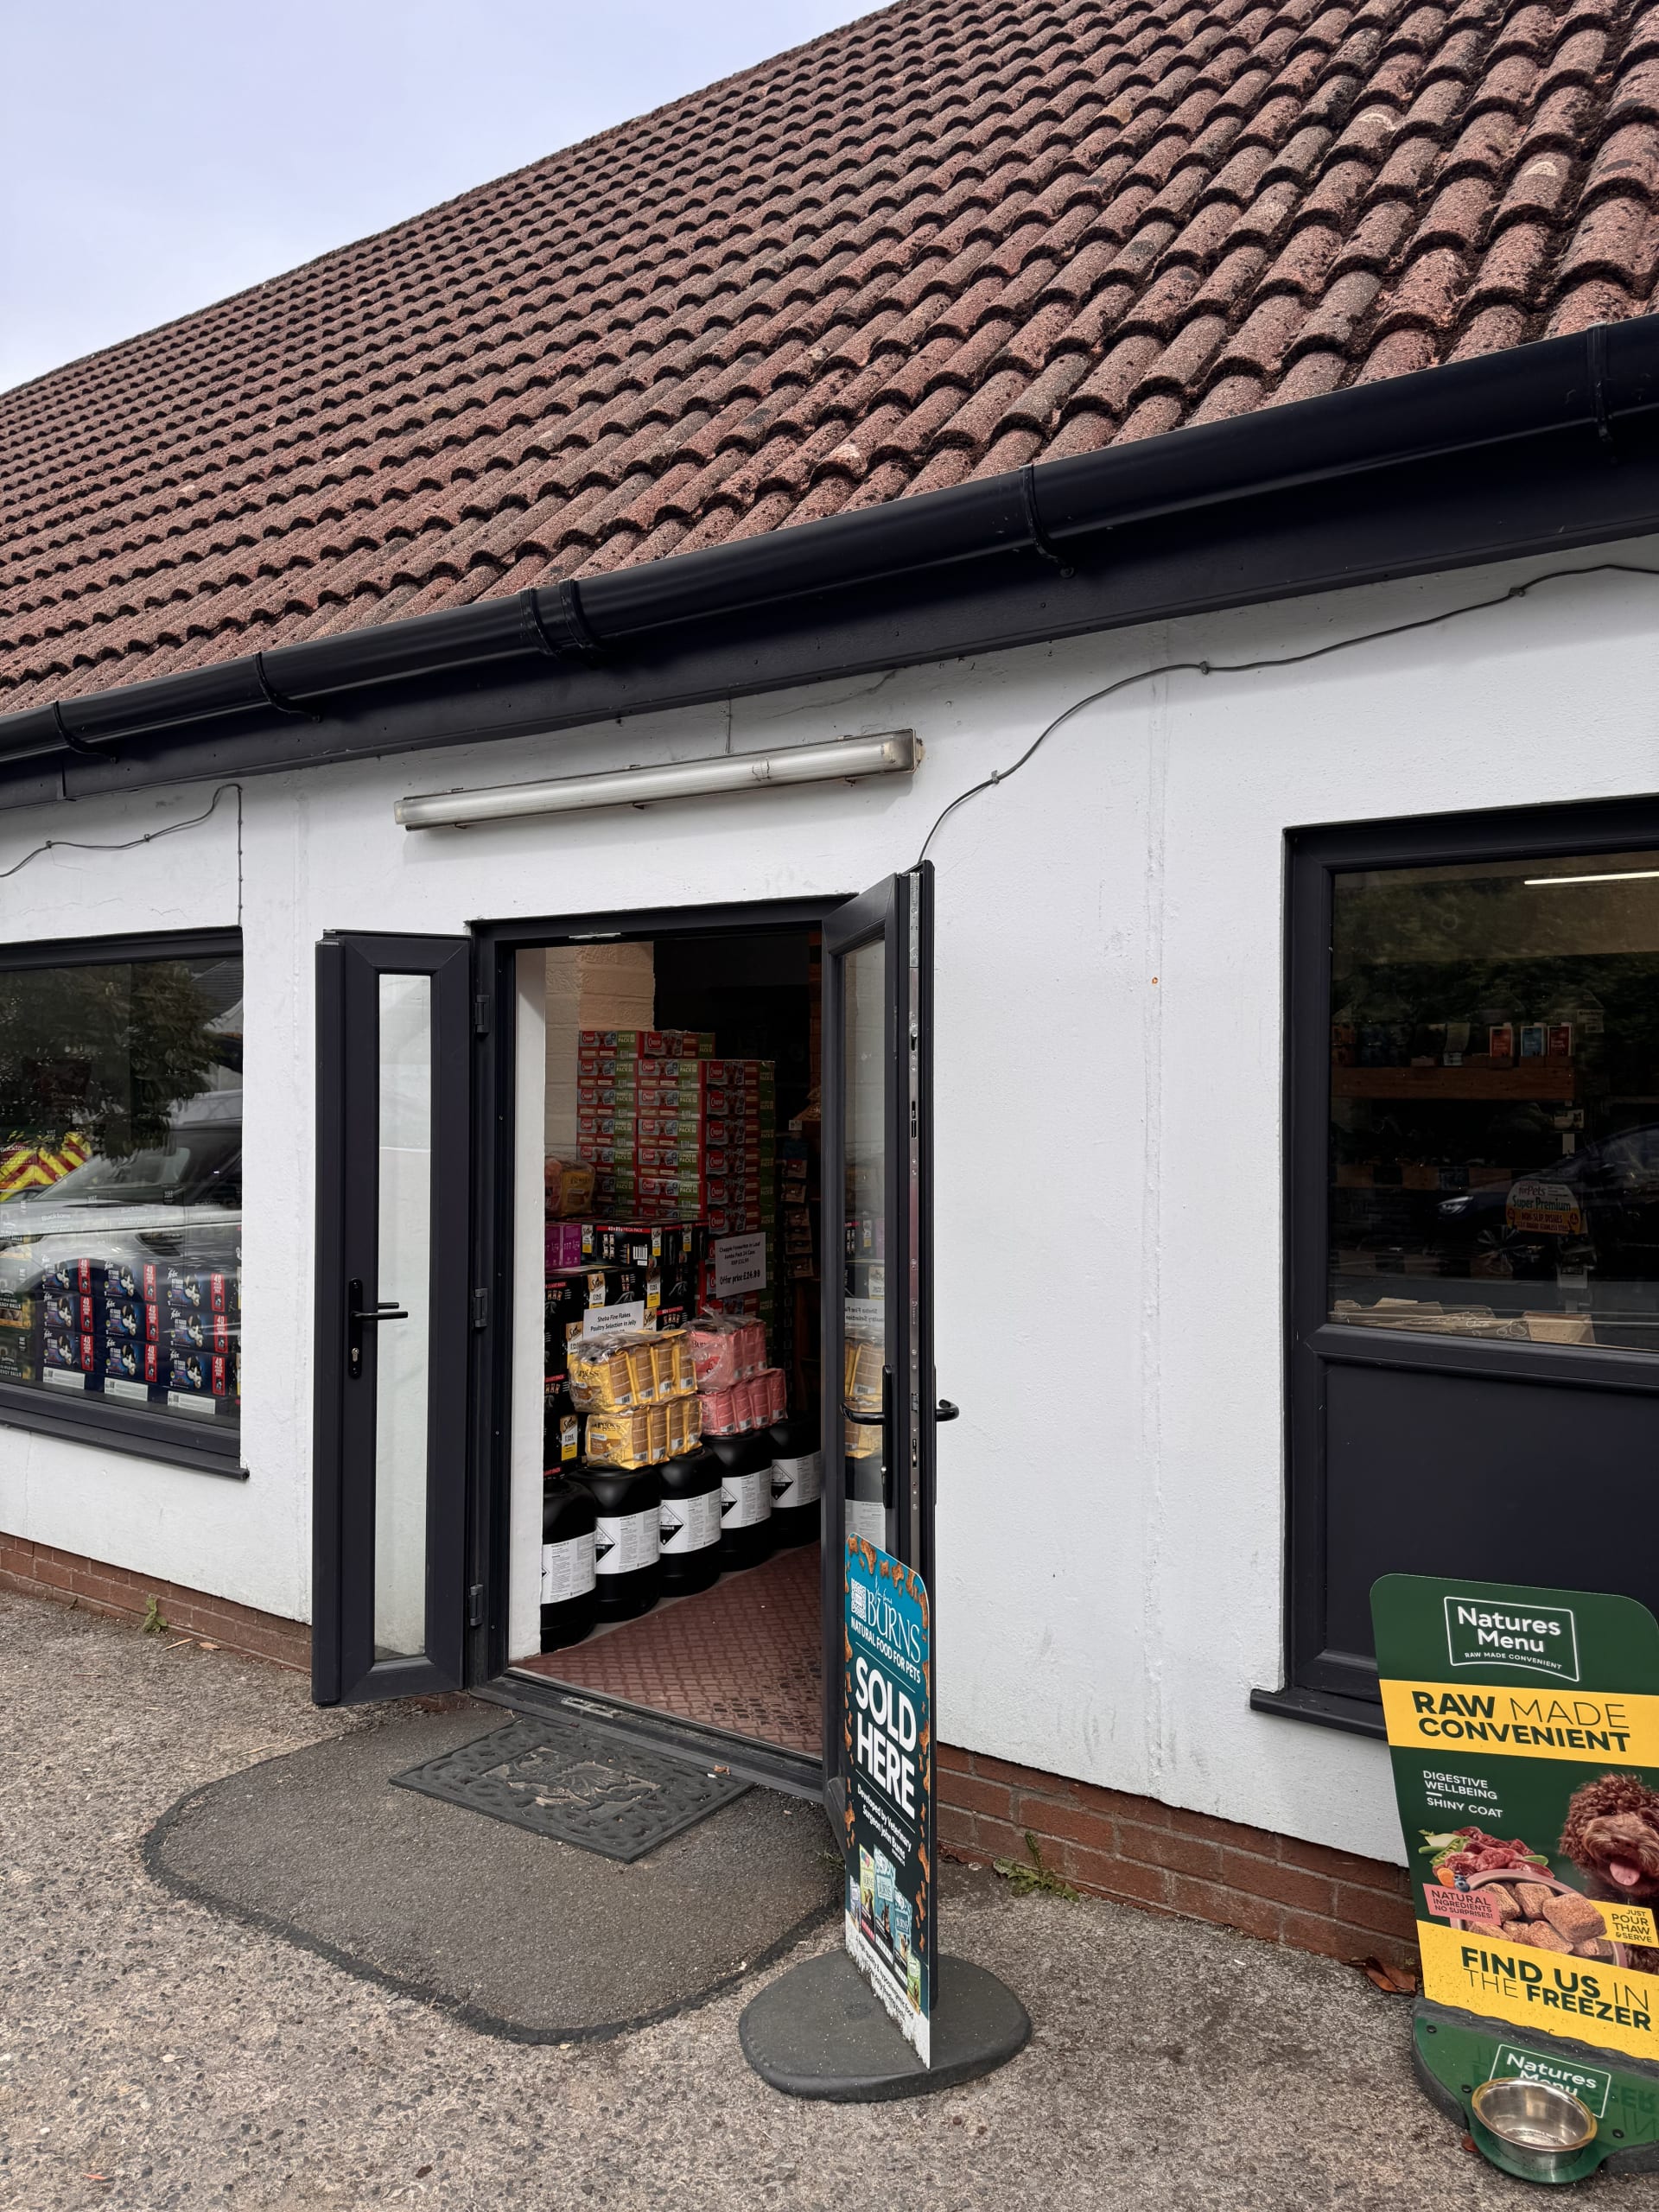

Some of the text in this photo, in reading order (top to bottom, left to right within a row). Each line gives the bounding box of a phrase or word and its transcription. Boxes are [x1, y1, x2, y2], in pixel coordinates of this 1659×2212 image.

[1513, 1195, 1571, 1211] Super Premium
[719, 1274, 731, 1285] Offer
[732, 1274, 743, 1285] price
[867, 1588, 921, 1663] BURNS
[1457, 1605, 1561, 1636] Natures
[851, 1616, 921, 1684] NATURAL FOOD FOR PETS
[1477, 1628, 1544, 1653] Menu
[1508, 1654, 1562, 1670] CONVENIENT
[855, 1656, 917, 1752] SOLD
[1411, 1690, 1630, 1729] RAW MADE
[1418, 1717, 1630, 1752] CONVENIENT
[857, 1712, 915, 1820] HERE
[1422, 1770, 1489, 1789] DIGESTIVE
[1424, 1780, 1498, 1800] WELLBEING
[857, 1783, 881, 1819] Developed
[880, 1808, 888, 1826] by
[887, 1815, 912, 1853] Veterinary
[1427, 1797, 1503, 1818] SHINY COAT
[862, 1803, 881, 1833] Surgeon
[880, 1823, 892, 1845] John
[892, 1835, 906, 1859] Burns
[1431, 1890, 1491, 1906] NATURAL
[1433, 1898, 1492, 1913] INGREDIENTS
[1449, 1907, 1494, 1919] SURPRISES!
[1611, 1913, 1649, 1926] POUR
[1612, 1922, 1649, 1935] THAW
[1461, 1946, 1649, 2012] FIND US IN
[1463, 1968, 1652, 2032] THE FREEZER
[1506, 2053, 1597, 2088] Natures
